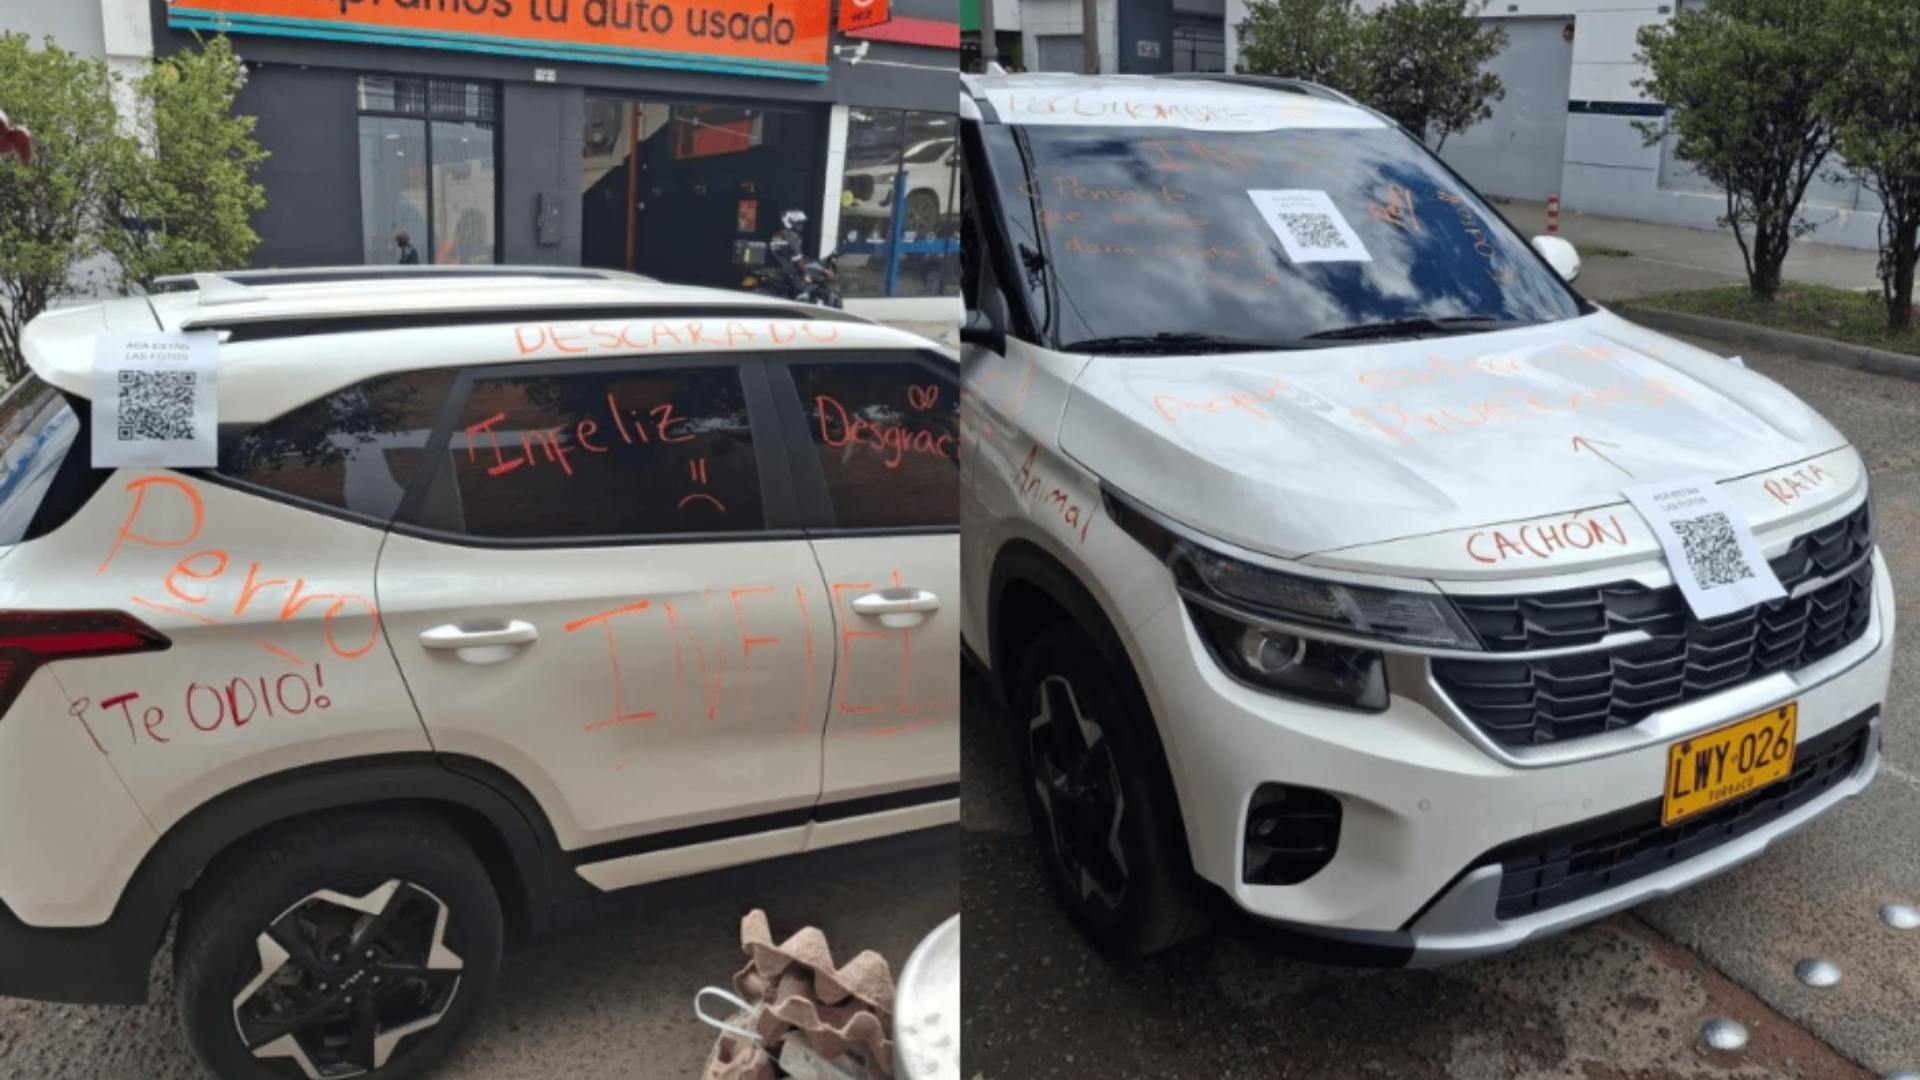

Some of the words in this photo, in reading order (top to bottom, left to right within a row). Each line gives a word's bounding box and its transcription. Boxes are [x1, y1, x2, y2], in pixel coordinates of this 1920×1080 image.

[529, 0, 568, 23] tu
[583, 0, 673, 34] auto
[687, 3, 795, 45] usado
[514, 320, 838, 355] DESCARADO
[466, 394, 697, 476] Infeliz
[1014, 443, 1098, 544] Animal
[1763, 462, 1830, 506] RATA
[1466, 508, 1630, 564] CACHÓN
[97, 474, 382, 659] Perro
[186, 663, 332, 732] ODIO!
[1738, 718, 1791, 775] 026
